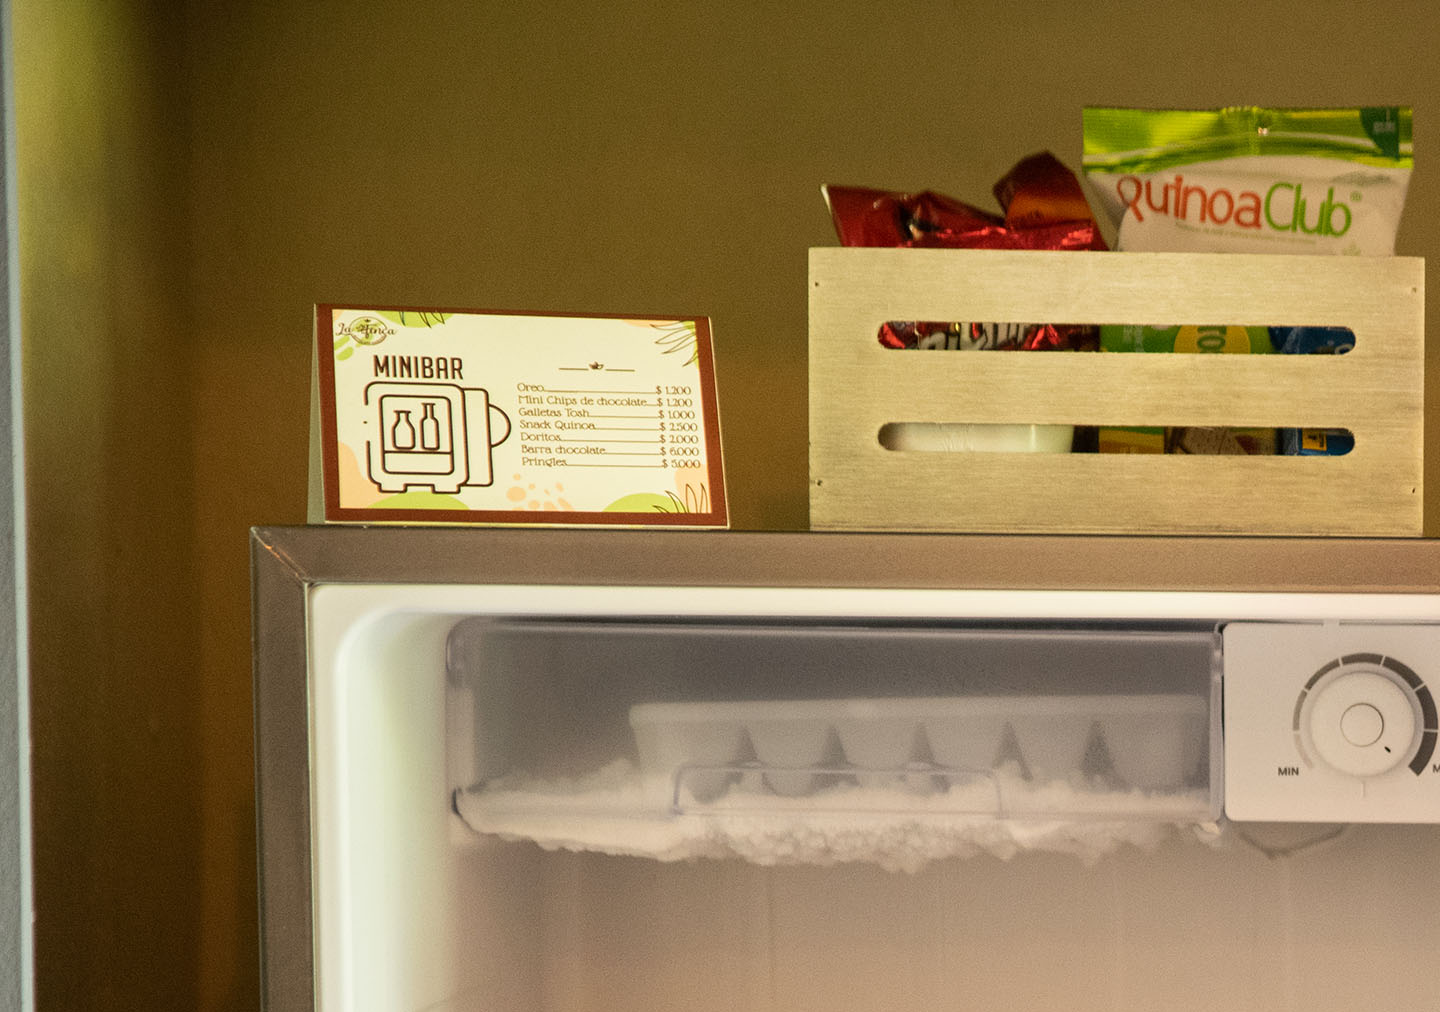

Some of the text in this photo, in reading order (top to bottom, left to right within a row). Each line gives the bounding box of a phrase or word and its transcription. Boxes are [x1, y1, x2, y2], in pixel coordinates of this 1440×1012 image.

[1117, 174, 1352, 237] QuinoaClub
[373, 355, 464, 380] MINIBAR
[1278, 768, 1299, 776] MIN
